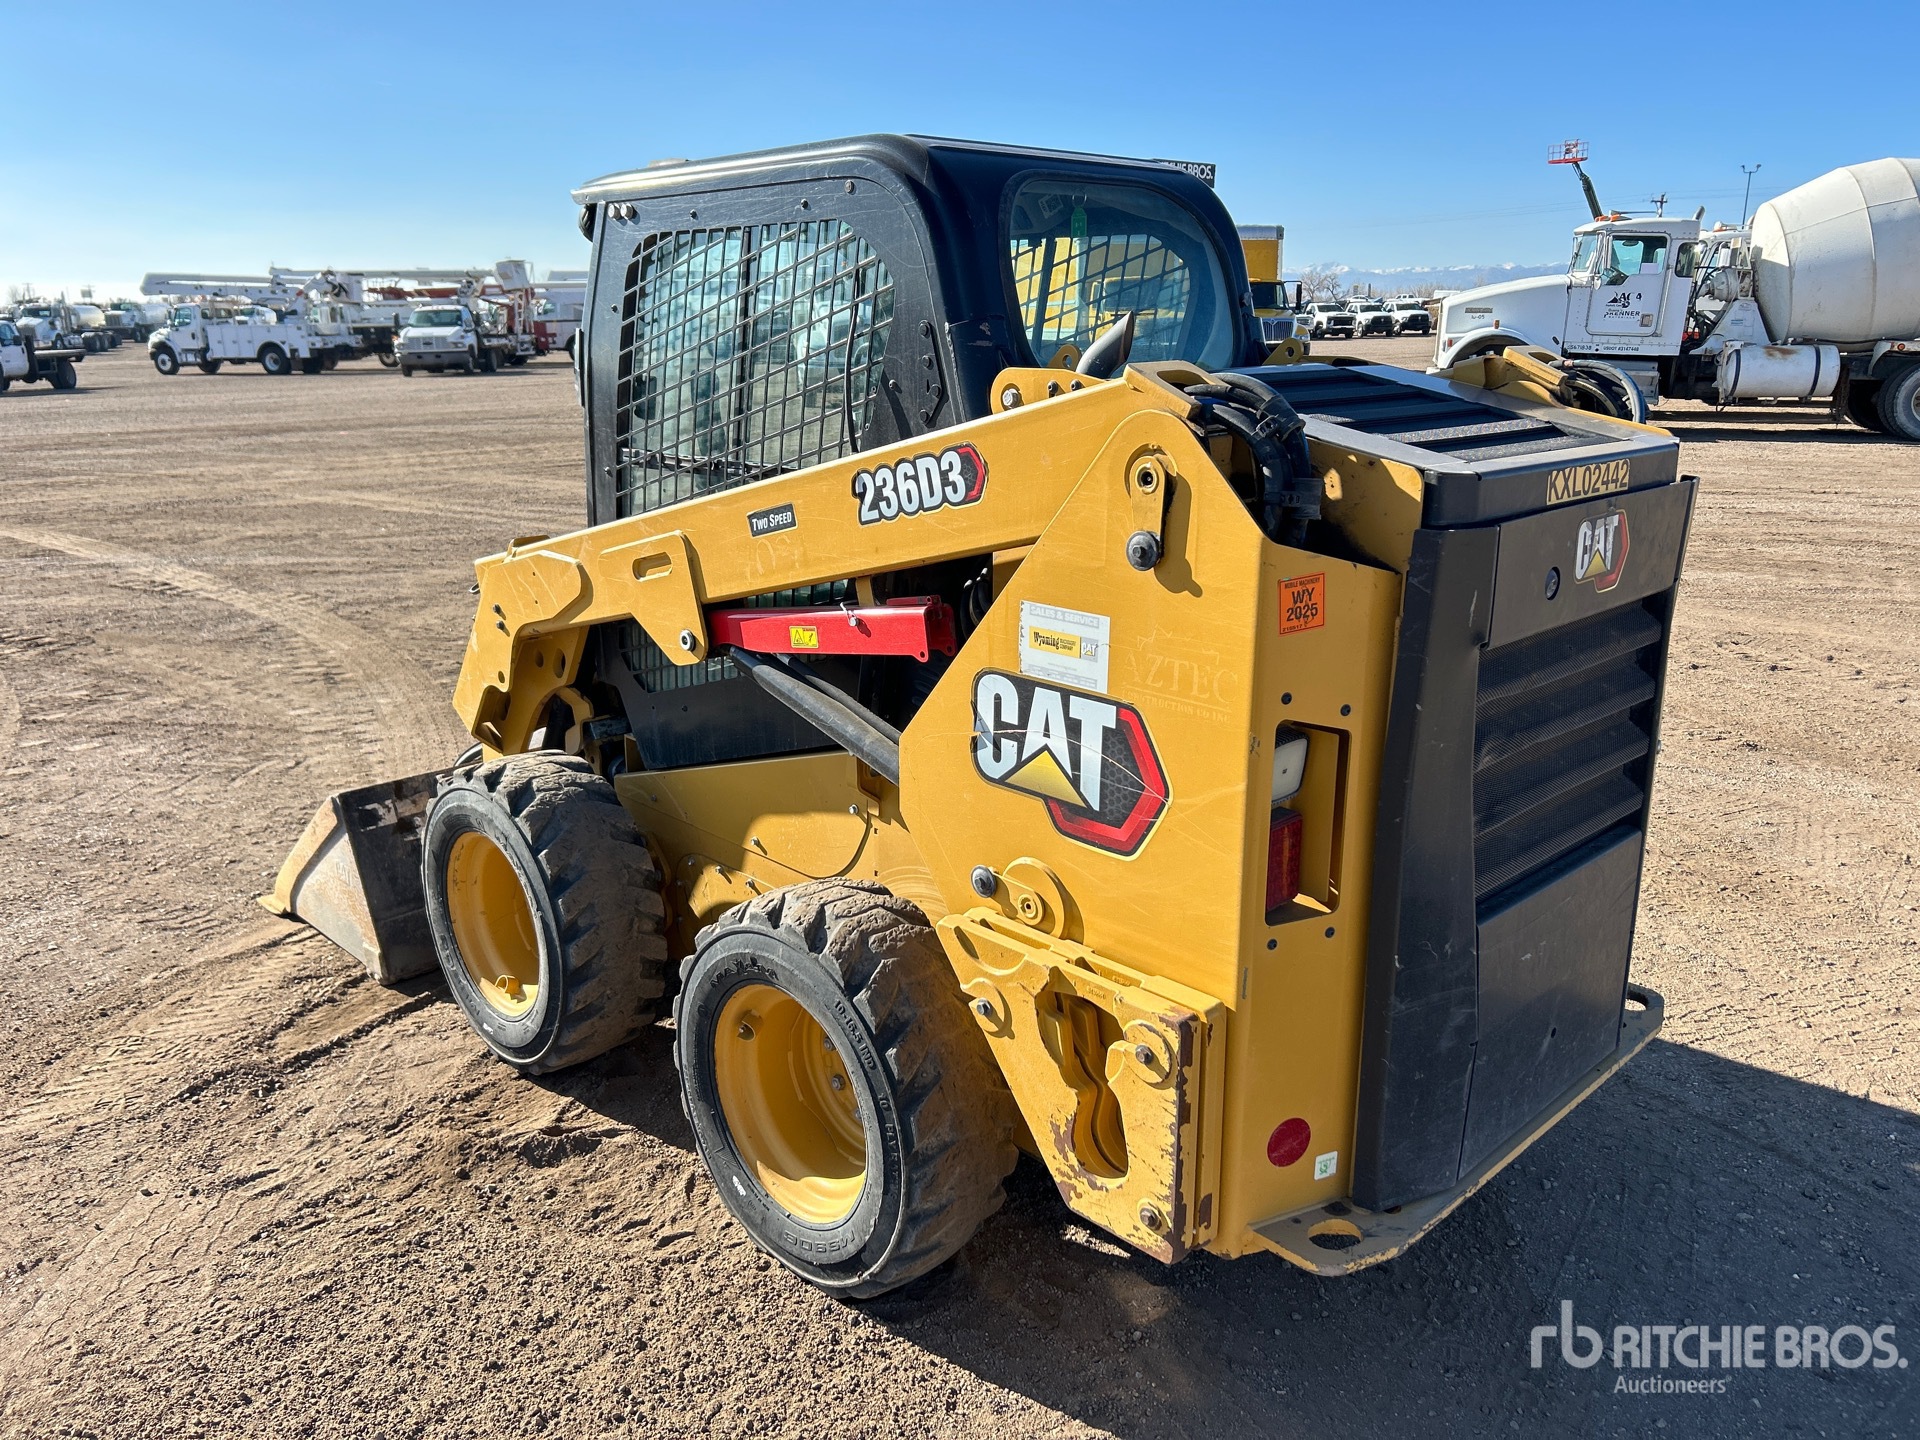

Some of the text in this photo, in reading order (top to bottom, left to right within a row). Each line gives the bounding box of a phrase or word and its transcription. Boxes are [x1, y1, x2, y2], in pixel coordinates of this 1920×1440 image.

[855, 450, 966, 521] 236D3
[1548, 459, 1629, 502] KXL02442
[1574, 513, 1619, 580] CAT
[1286, 602, 1318, 622] 2025
[1292, 586, 1315, 605] WY
[1029, 605, 1099, 628] SALES & SERVICE
[1033, 631, 1060, 650] Wyoming
[1082, 642, 1098, 657] CAT
[1124, 650, 1239, 704] AZTEC
[974, 673, 1117, 812] CAT
